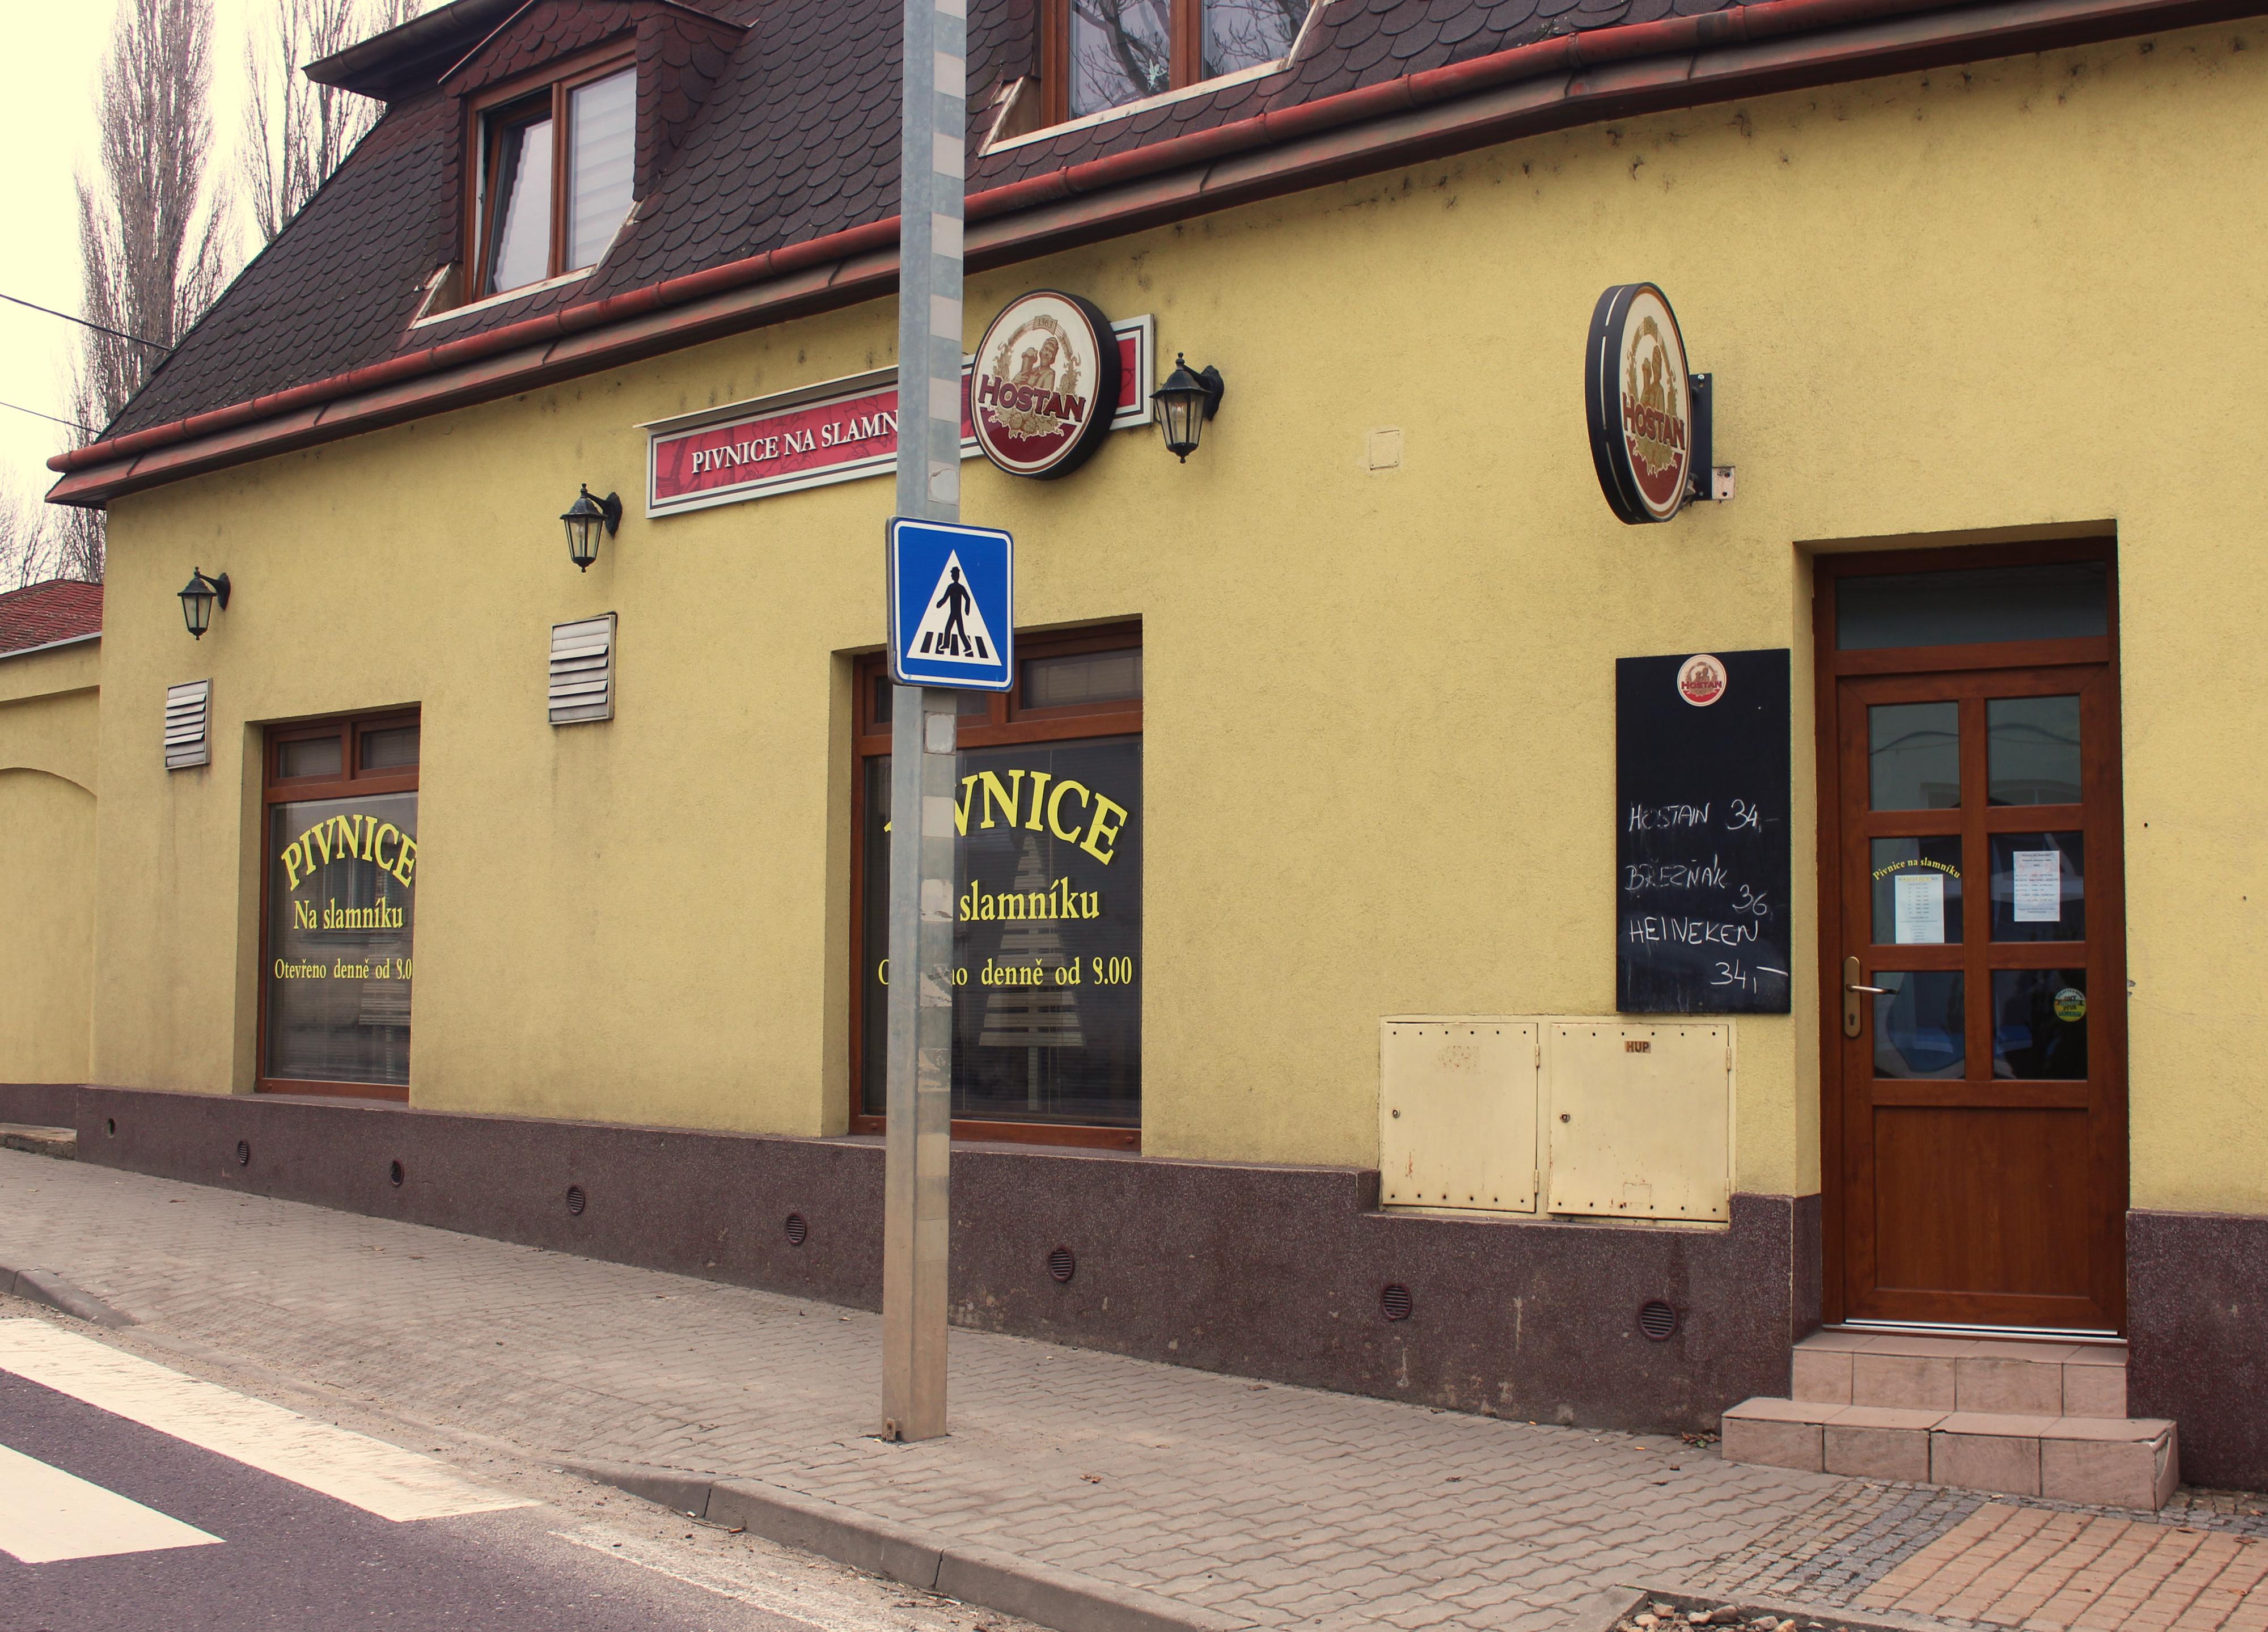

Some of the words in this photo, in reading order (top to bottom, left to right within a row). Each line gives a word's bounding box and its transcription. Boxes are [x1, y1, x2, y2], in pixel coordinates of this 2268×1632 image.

[1038, 317, 1053, 328] 1363
[979, 374, 1086, 422] HOSTAN
[1622, 392, 1685, 450] HOSTAN
[691, 436, 780, 473] PIVNICE
[784, 428, 816, 455] NA
[822, 409, 899, 447] SLAMN
[1681, 680, 1722, 690] HOSTAN
[884, 770, 1128, 865] VNICE
[281, 814, 417, 891] PIVNICE
[1872, 861, 1906, 881] Pivnice
[1920, 857, 1960, 878] slamníku
[294, 900, 318, 929] Na
[323, 897, 404, 929] slamníku
[959, 877, 1099, 921] slamníku
[1630, 916, 1758, 946] HEINEKEN
[274, 958, 327, 979] Otevřeno
[333, 958, 370, 979] denně
[375, 958, 390, 979] od
[396, 958, 413, 980] 8.0
[981, 958, 1044, 986] denně
[1055, 957, 1081, 986] od
[1627, 1041, 1649, 1053] HUP
